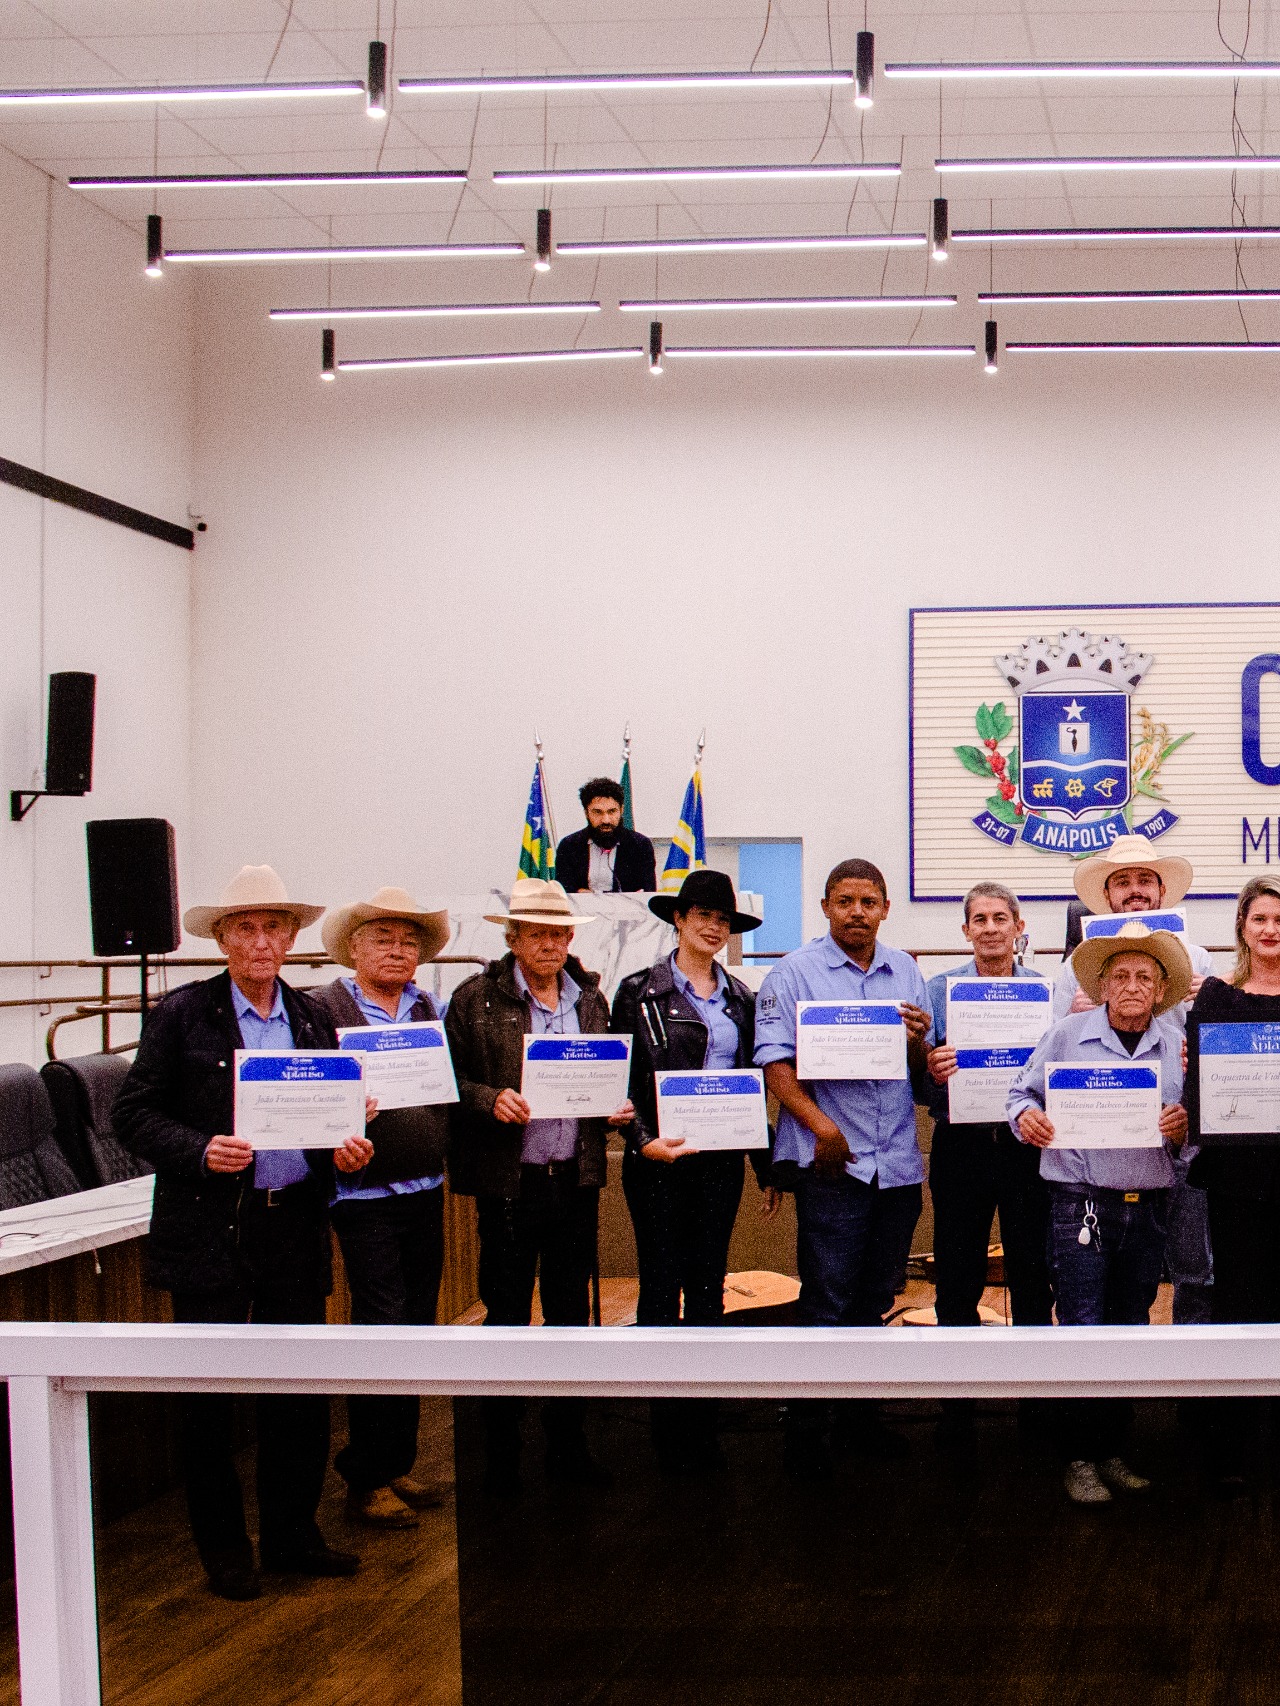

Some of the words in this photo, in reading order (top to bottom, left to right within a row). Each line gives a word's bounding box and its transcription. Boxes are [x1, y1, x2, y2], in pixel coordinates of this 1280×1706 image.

[981, 817, 1010, 841] 31-07
[1033, 821, 1120, 848] ANÁPOLIS
[1144, 815, 1167, 836] 1907
[1211, 1073, 1250, 1084] Orquestra
[1252, 1072, 1262, 1081] de
